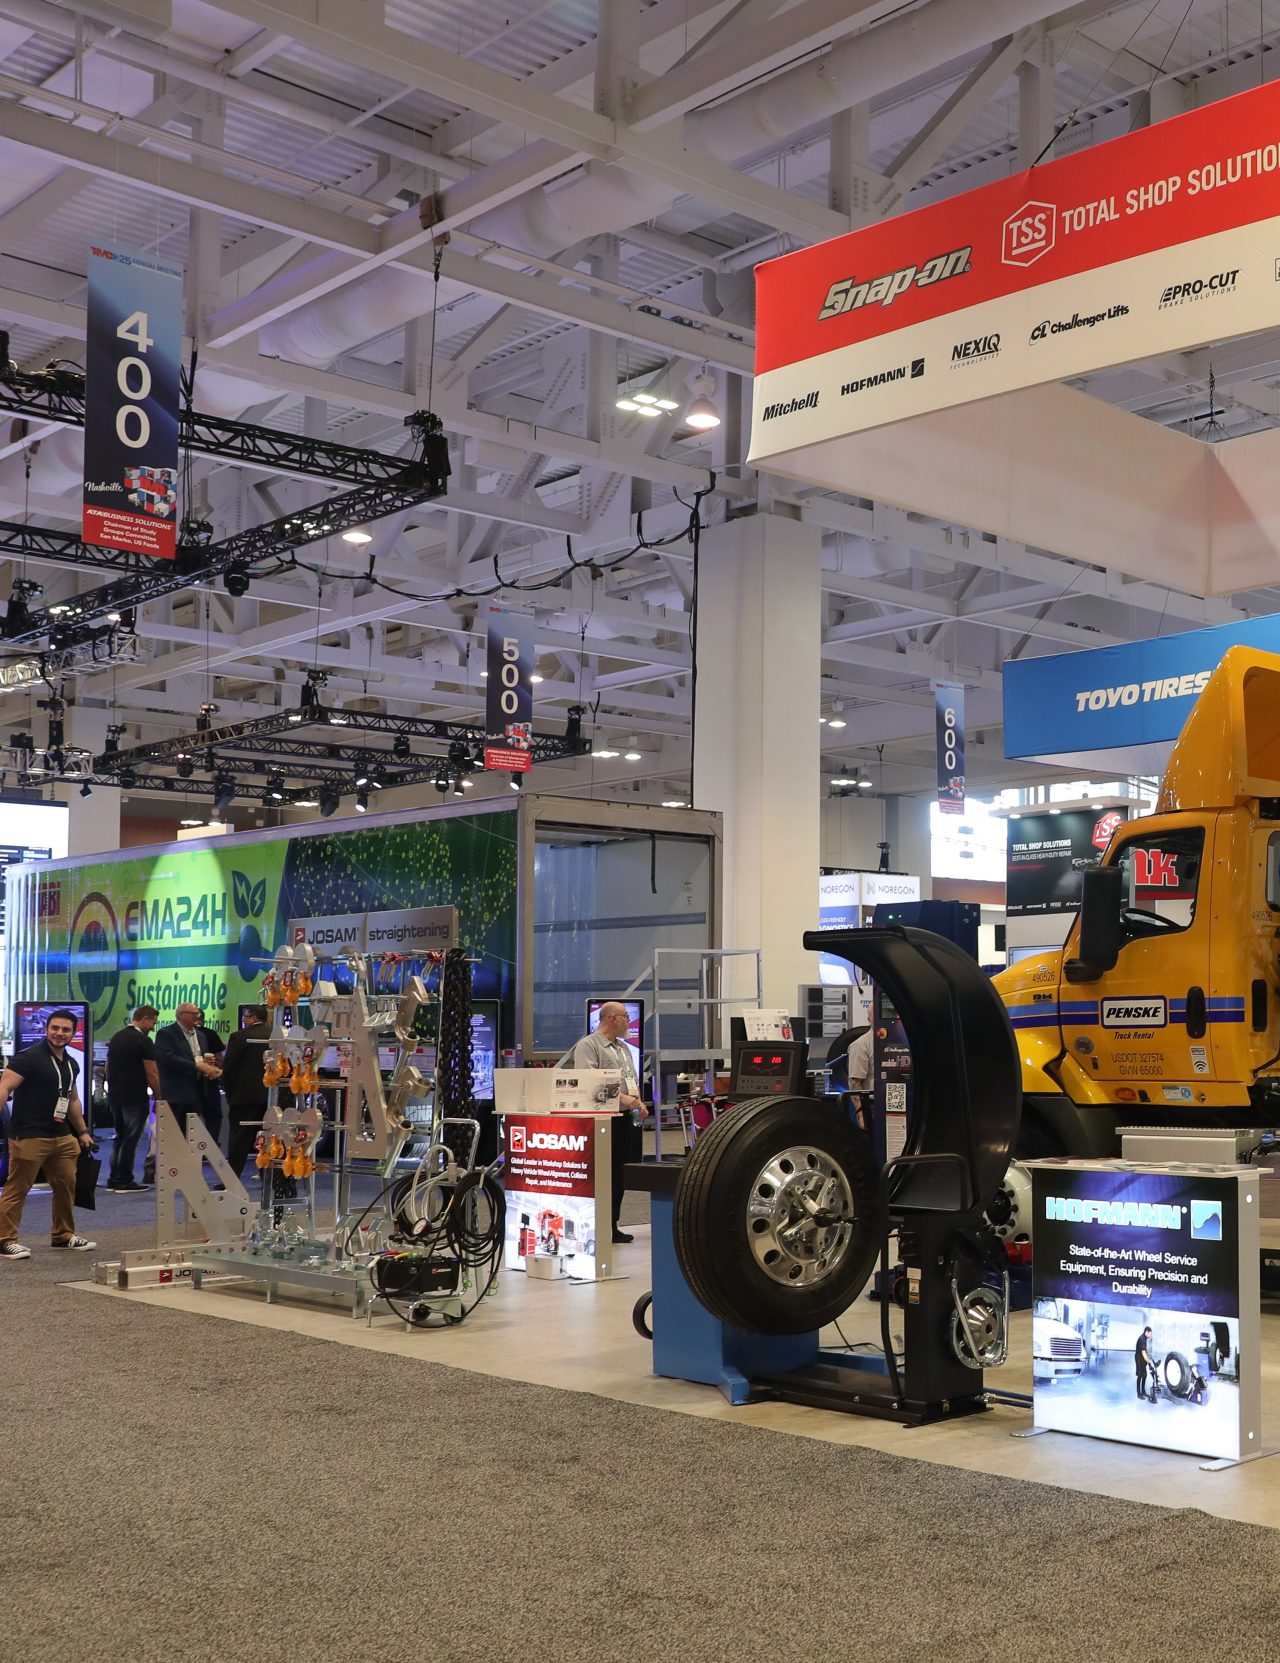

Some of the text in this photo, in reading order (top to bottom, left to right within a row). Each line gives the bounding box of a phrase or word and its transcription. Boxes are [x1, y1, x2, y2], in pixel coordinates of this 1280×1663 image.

[1062, 196, 1120, 235] TOTAL
[1125, 175, 1181, 215] SHOP
[1009, 213, 1047, 246] TSS
[817, 245, 972, 321] Snap-on
[1169, 269, 1241, 303] PRO-CUT
[1158, 285, 1238, 310] BRAKE SOLUTIONS
[1050, 311, 1106, 335] Challenger
[1107, 304, 1129, 319] Lifts
[951, 333, 1002, 361] NEXIQ
[950, 352, 1000, 370] TECHNOLOGIES
[116, 311, 154, 449] 400
[841, 365, 906, 396] HOFMANN
[762, 390, 820, 422] Mitchell1
[85, 481, 124, 492] Nashville
[103, 520, 131, 531] Chairman
[139, 527, 157, 536] Study
[103, 527, 157, 542] Groups Committee
[134, 518, 172, 531] SOLUTIONS
[501, 637, 520, 715] 500
[1075, 670, 1212, 712] TOYO TIRES
[944, 708, 956, 770] 600
[1013, 839, 1071, 852] TOTAL SHOP SOLUTIONS
[821, 885, 855, 894] NOREGON
[879, 885, 915, 895] NOREGON
[125, 892, 228, 942] EMA24H
[308, 923, 450, 945] JOSAM straightening
[1032, 971, 1055, 982] 490526
[126, 972, 228, 1011] Sustainable
[1106, 1006, 1162, 1019] PENSKE
[1114, 1031, 1155, 1040] Truck Rental
[1111, 1052, 1165, 1063] USDOT 327574
[1120, 1066, 1138, 1076] GVW
[527, 1133, 585, 1151] JOSAM
[511, 1157, 523, 1165] Global
[524, 1158, 537, 1166] Leader
[543, 1160, 562, 1168] Workshop
[563, 1161, 581, 1169] Solutions
[511, 1167, 523, 1175] Heavy
[538, 1169, 550, 1177] Wheel
[550, 1170, 570, 1179] Alignment,
[571, 1171, 587, 1179] Collision
[525, 1178, 539, 1186] Repair,
[548, 1180, 572, 1188] Maintenance
[1045, 1196, 1182, 1230] HOFMANN
[1069, 1244, 1198, 1267] State-of-the-Art Wheel Service
[175, 1269, 217, 1278] JOA
[1060, 1260, 1208, 1286] Equipment, Ensuring Precision and
[1112, 1281, 1153, 1299] Durability
